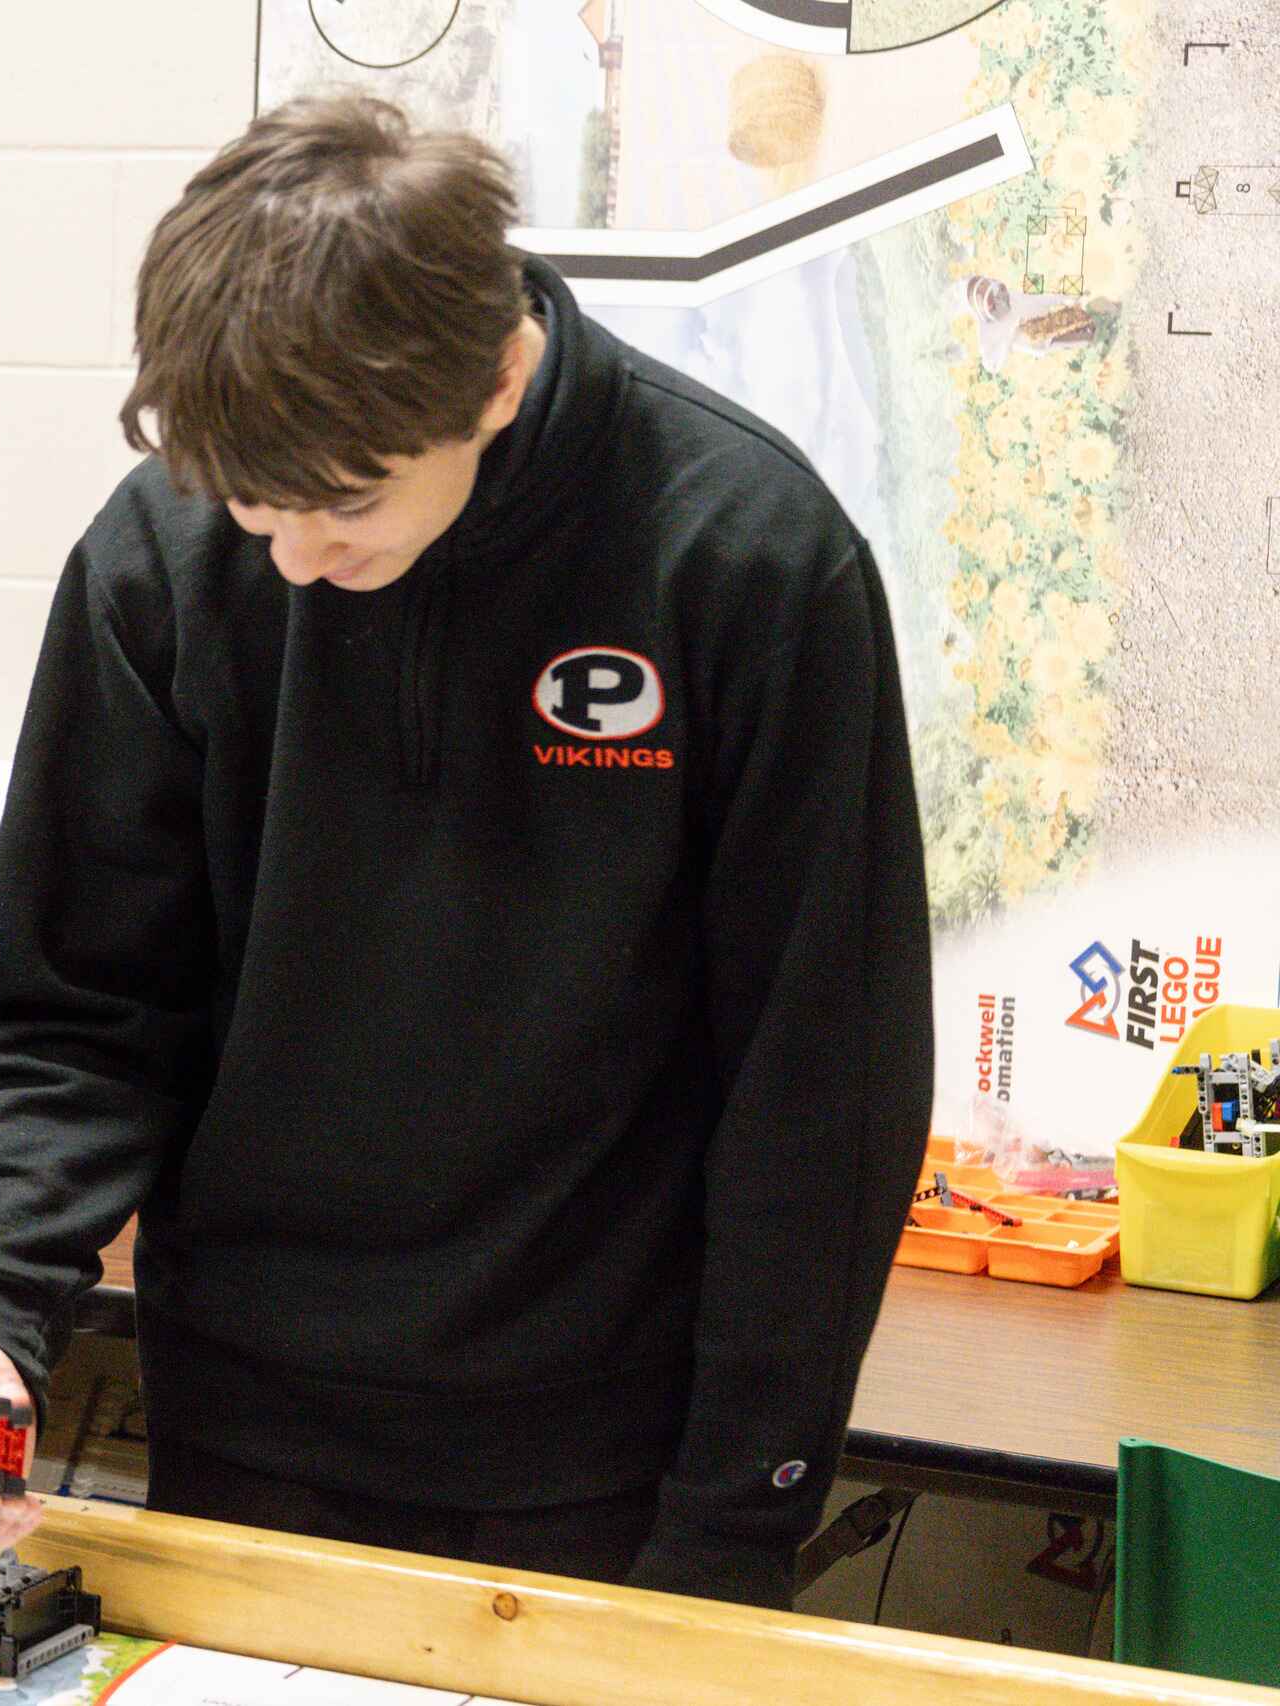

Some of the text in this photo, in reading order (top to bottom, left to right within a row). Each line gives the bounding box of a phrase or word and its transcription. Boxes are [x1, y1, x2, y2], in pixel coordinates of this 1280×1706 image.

[550, 654, 645, 732] P
[533, 744, 675, 769] VIKINGS
[1126, 939, 1160, 1050] FIRST
[1160, 957, 1189, 1043] LEGO
[1192, 936, 1222, 1017] GUE
[976, 994, 995, 1092] ockwell
[996, 996, 1015, 1102] omation
